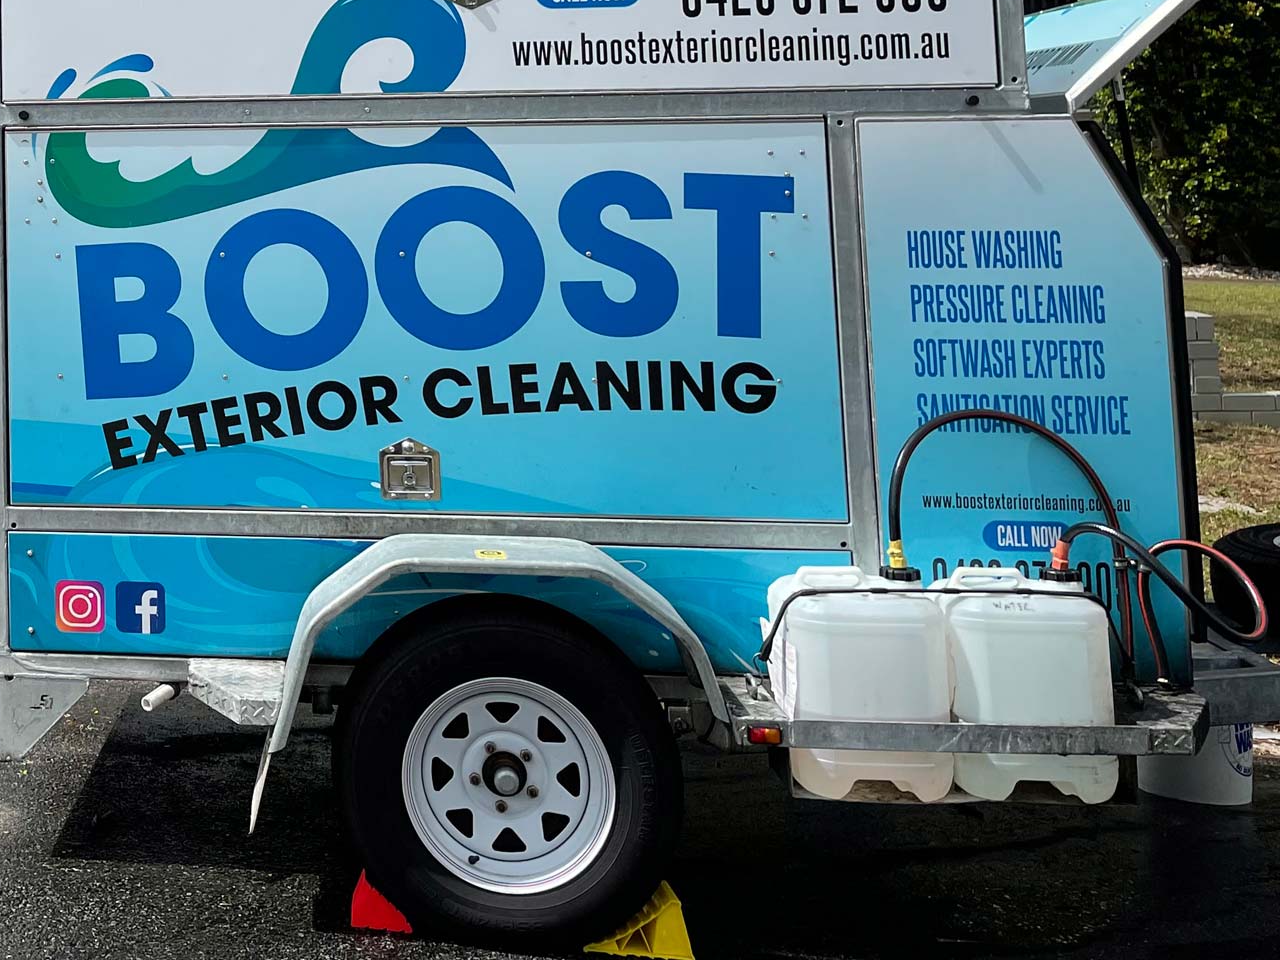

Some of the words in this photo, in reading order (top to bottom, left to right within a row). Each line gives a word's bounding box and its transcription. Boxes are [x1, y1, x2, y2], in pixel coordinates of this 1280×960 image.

[512, 27, 950, 67] www.boostexteriorcleaning.com.au
[907, 230, 967, 269] HOUSE
[972, 230, 1063, 269] WASHING
[75, 170, 795, 400] BOOST
[910, 284, 1006, 324] PRESSURE
[1011, 284, 1106, 324] CLEANING
[913, 338, 1016, 379] SOFTWASH
[1021, 339, 1106, 380] EXPERTS
[102, 375, 402, 470] EXTERIOR
[422, 360, 778, 419] CLEANING
[1051, 394, 1132, 435] SERVICE
[922, 492, 1131, 514] www.boostexteriorcleaning.co.au
[997, 524, 1029, 547] CALL
[1031, 525, 1062, 548] NOW
